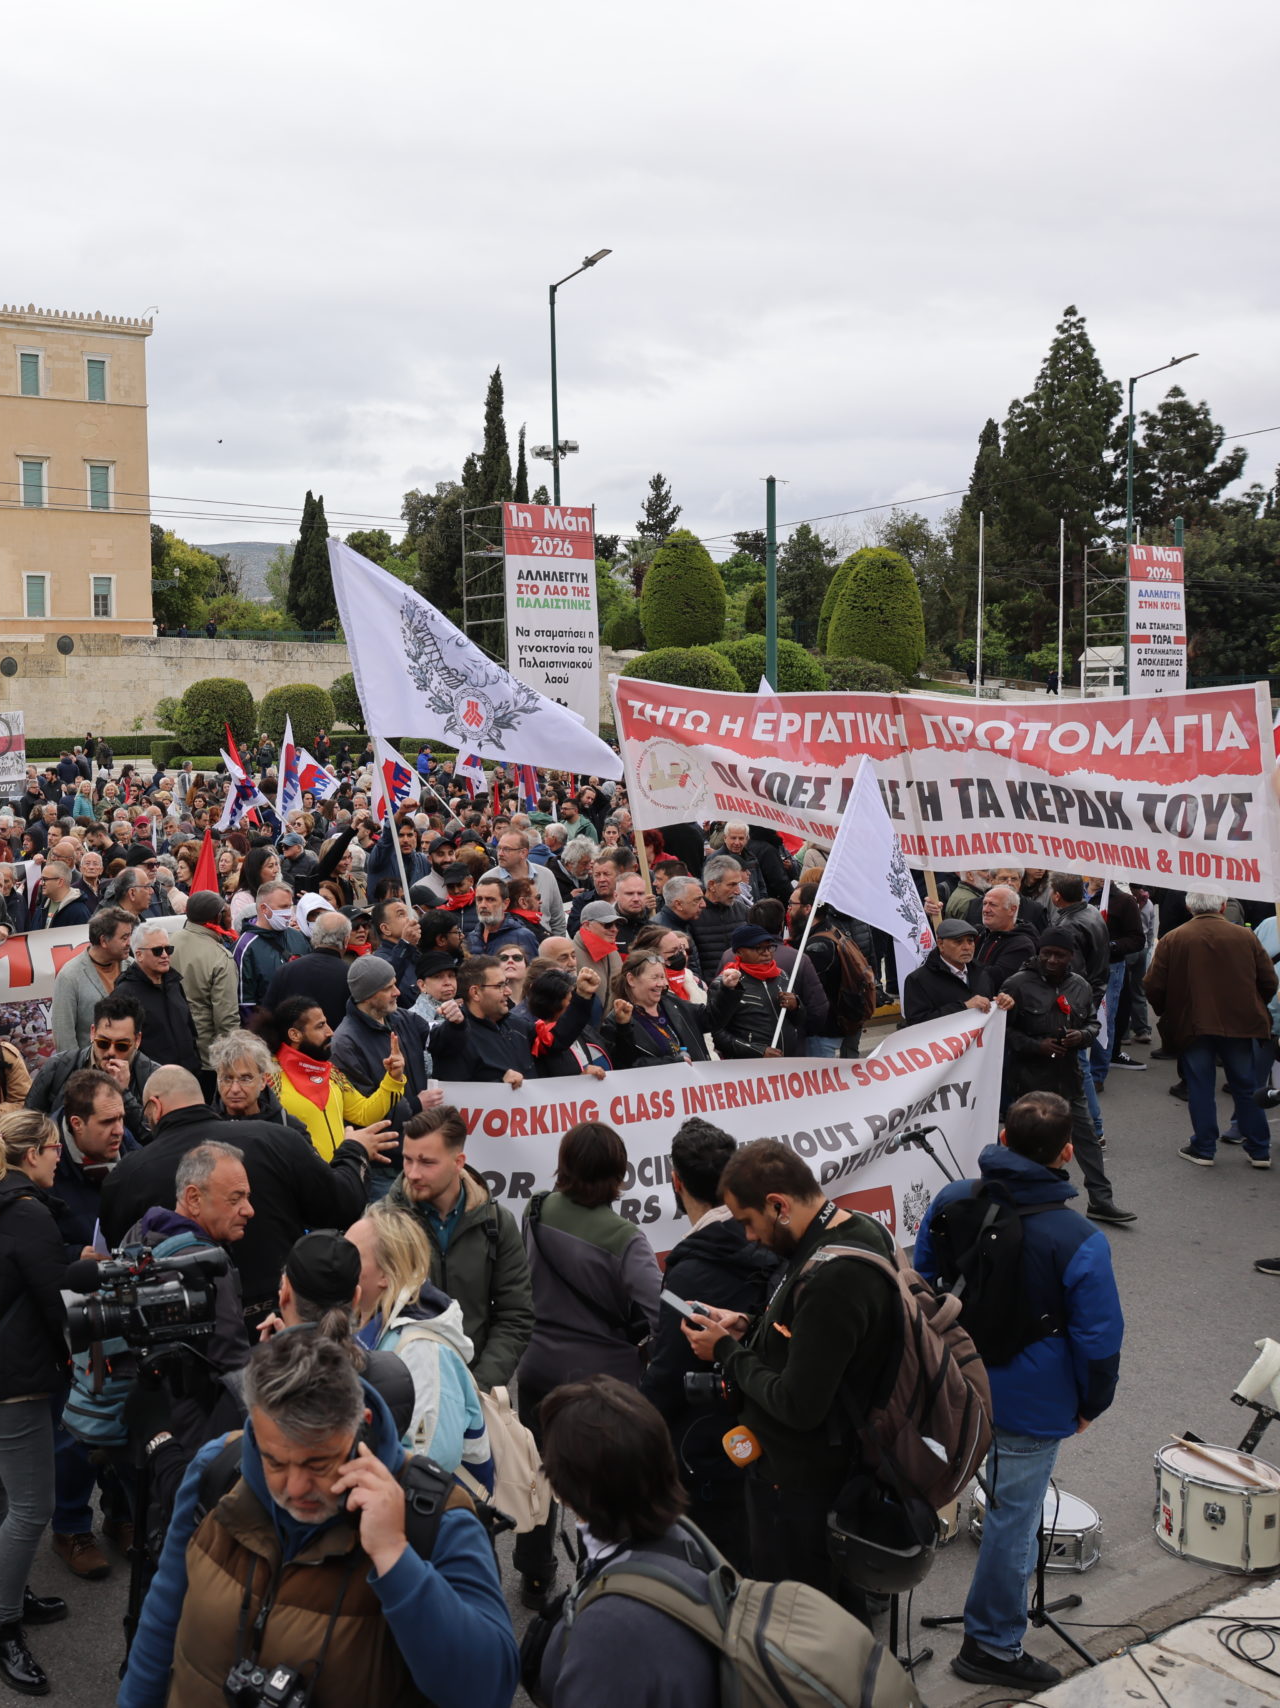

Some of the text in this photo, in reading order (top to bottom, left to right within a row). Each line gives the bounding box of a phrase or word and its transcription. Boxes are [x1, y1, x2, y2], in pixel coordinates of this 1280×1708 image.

[531, 536, 574, 557] 2026
[517, 569, 588, 583] ΑΛΛΗΛΕΓΓΥΗ
[1146, 566, 1173, 581] 2026
[516, 584, 590, 598] ΣΤΟ ΛΑΟ ΤΗΣ
[1138, 589, 1181, 600] ΑΛΛΗΛΕΓΓΥΗ
[516, 597, 591, 610] ΠΑΛΑΙΣΤΙΝΗΣ
[1138, 601, 1182, 611] ΣΤΗΝ ΚΟΥΒΑ
[1136, 622, 1147, 630] ΝΑ
[516, 627, 530, 637] Να
[534, 628, 586, 640] σταματήσει
[1152, 634, 1172, 645] ΤΩΡΑ
[517, 643, 593, 655] γενοκτονία του
[519, 657, 593, 669] Παλαιστινιακού
[1137, 658, 1183, 667] ΑΠΟΚΛΕΙΣΜΟΣ
[544, 671, 569, 684] λαού
[1141, 669, 1155, 677] ΑΠΟ
[1157, 669, 1166, 677] ΤΙΣ
[627, 700, 1250, 755] ΖΗΤΩ Η ΕΡΓΑΤΙΚΗ ΠΡΩΤΟΜΑΓΙΑ
[711, 761, 746, 792] ΟΙ
[747, 767, 831, 810] ΖΩΕΣ
[950, 778, 1005, 819] ΤΑ
[1005, 780, 1133, 831] ΚΕΡΔΗ
[1137, 792, 1253, 841] ΤΟΥΣ
[713, 793, 811, 833] ΠΑΝΕΛΛΗΝΙΑ
[930, 831, 1038, 857] ΓΑΛΑΚΤΟΣ
[1038, 834, 1151, 870] ΤΡΟΦΙΜΩΝ
[1157, 849, 1173, 873] &
[1179, 851, 1261, 883] ΠΟΤΩΝ
[610, 1089, 675, 1125] CLASS
[681, 1066, 849, 1115] INTERNATIONAL
[482, 1170, 535, 1199] OR
[819, 1201, 836, 1223] ONY
